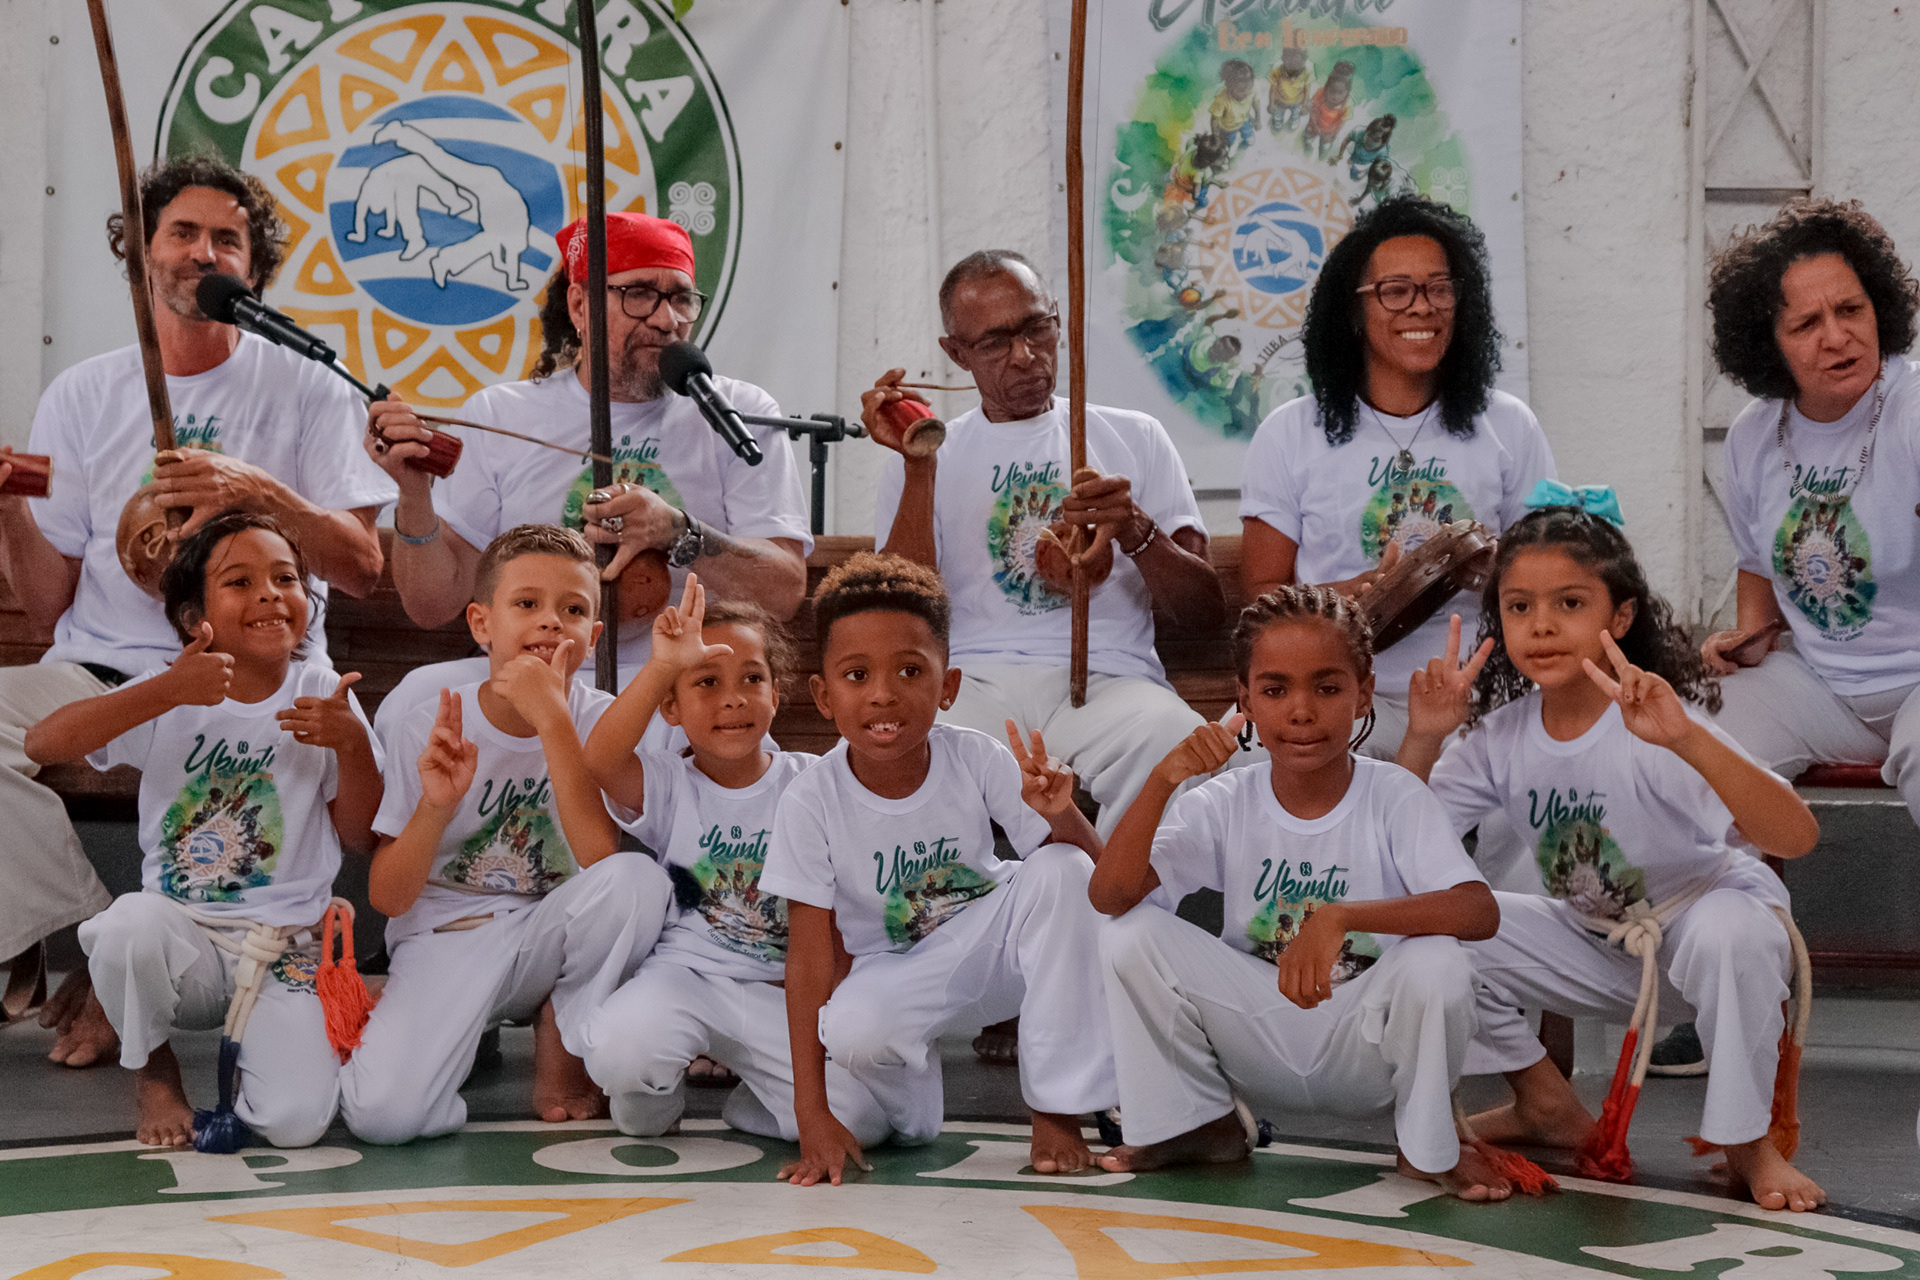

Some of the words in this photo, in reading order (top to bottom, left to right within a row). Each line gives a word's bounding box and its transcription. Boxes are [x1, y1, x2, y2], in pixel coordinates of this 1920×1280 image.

[151, 415, 223, 449] buntu
[991, 460, 1062, 493] Ubuntu
[873, 836, 961, 895] Ubuntu
[1253, 858, 1350, 903] Ubuntu
